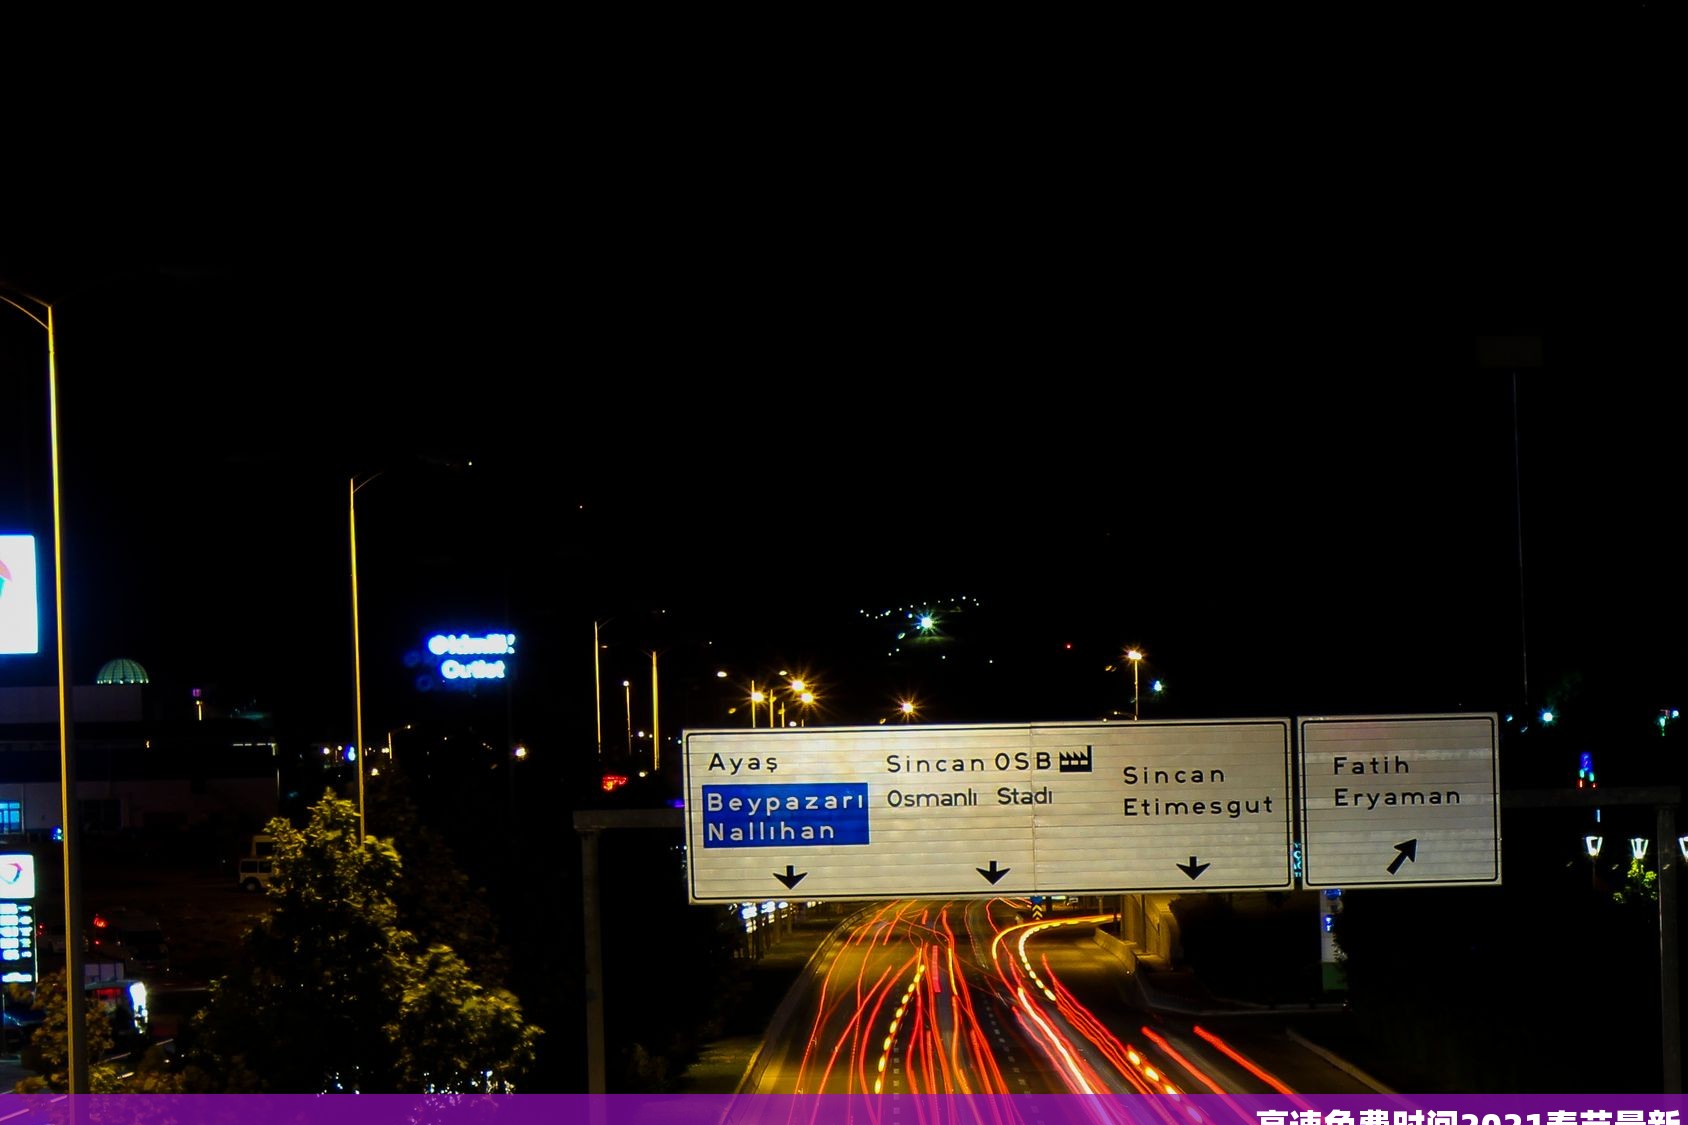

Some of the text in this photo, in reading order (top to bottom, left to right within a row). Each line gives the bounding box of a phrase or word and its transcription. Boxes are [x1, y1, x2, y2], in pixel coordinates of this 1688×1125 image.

[708, 753, 778, 776] Ayaş
[887, 752, 1051, 773] Sincan OSB
[1333, 756, 1409, 775] Fatih
[1123, 766, 1225, 785] Sincan
[707, 792, 864, 816] Beypazarı
[887, 786, 1053, 807] Osmanlı Stadı
[1124, 795, 1273, 818] Etimesgut
[1334, 788, 1460, 811] Eryaman
[708, 821, 834, 841] Nallıhan
